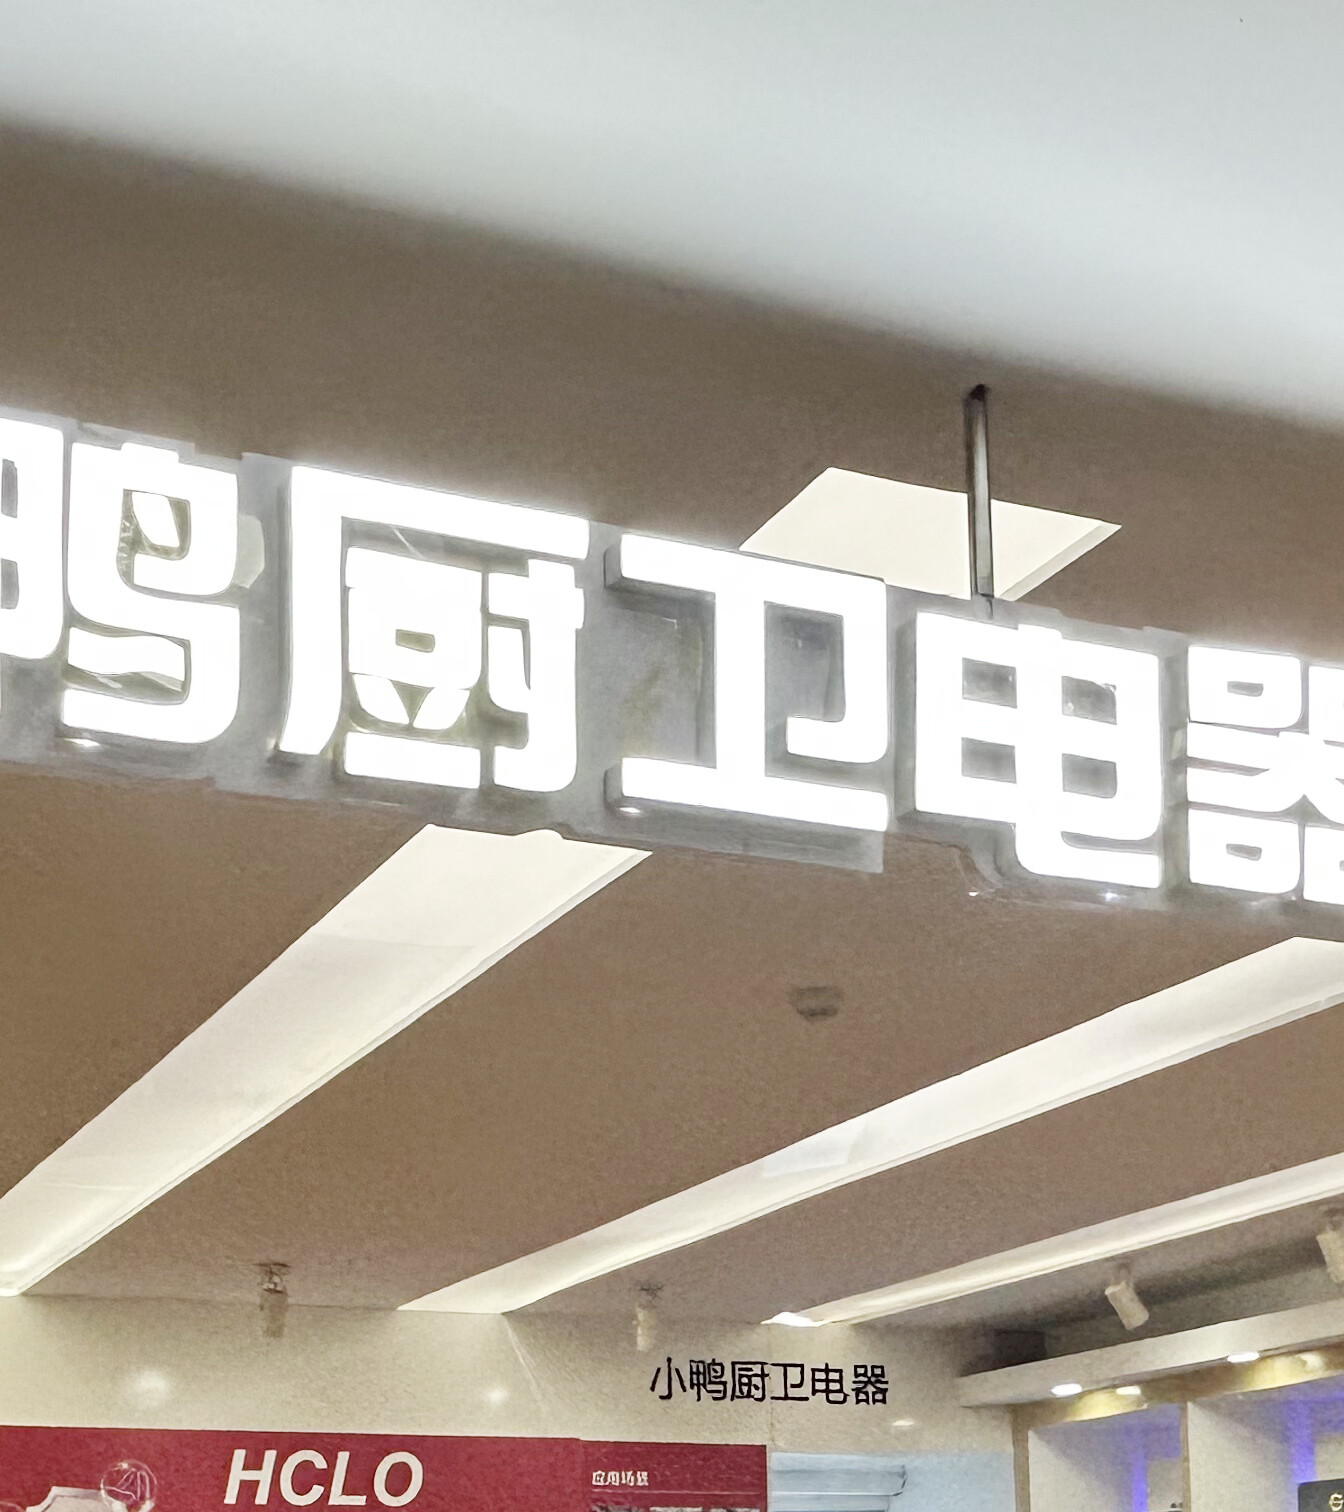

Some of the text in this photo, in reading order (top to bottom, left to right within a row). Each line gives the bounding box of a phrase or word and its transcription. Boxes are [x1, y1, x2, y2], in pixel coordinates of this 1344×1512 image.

[649, 1356, 889, 1405] 小鸭厨卫电器
[223, 1448, 425, 1507] HCLO
